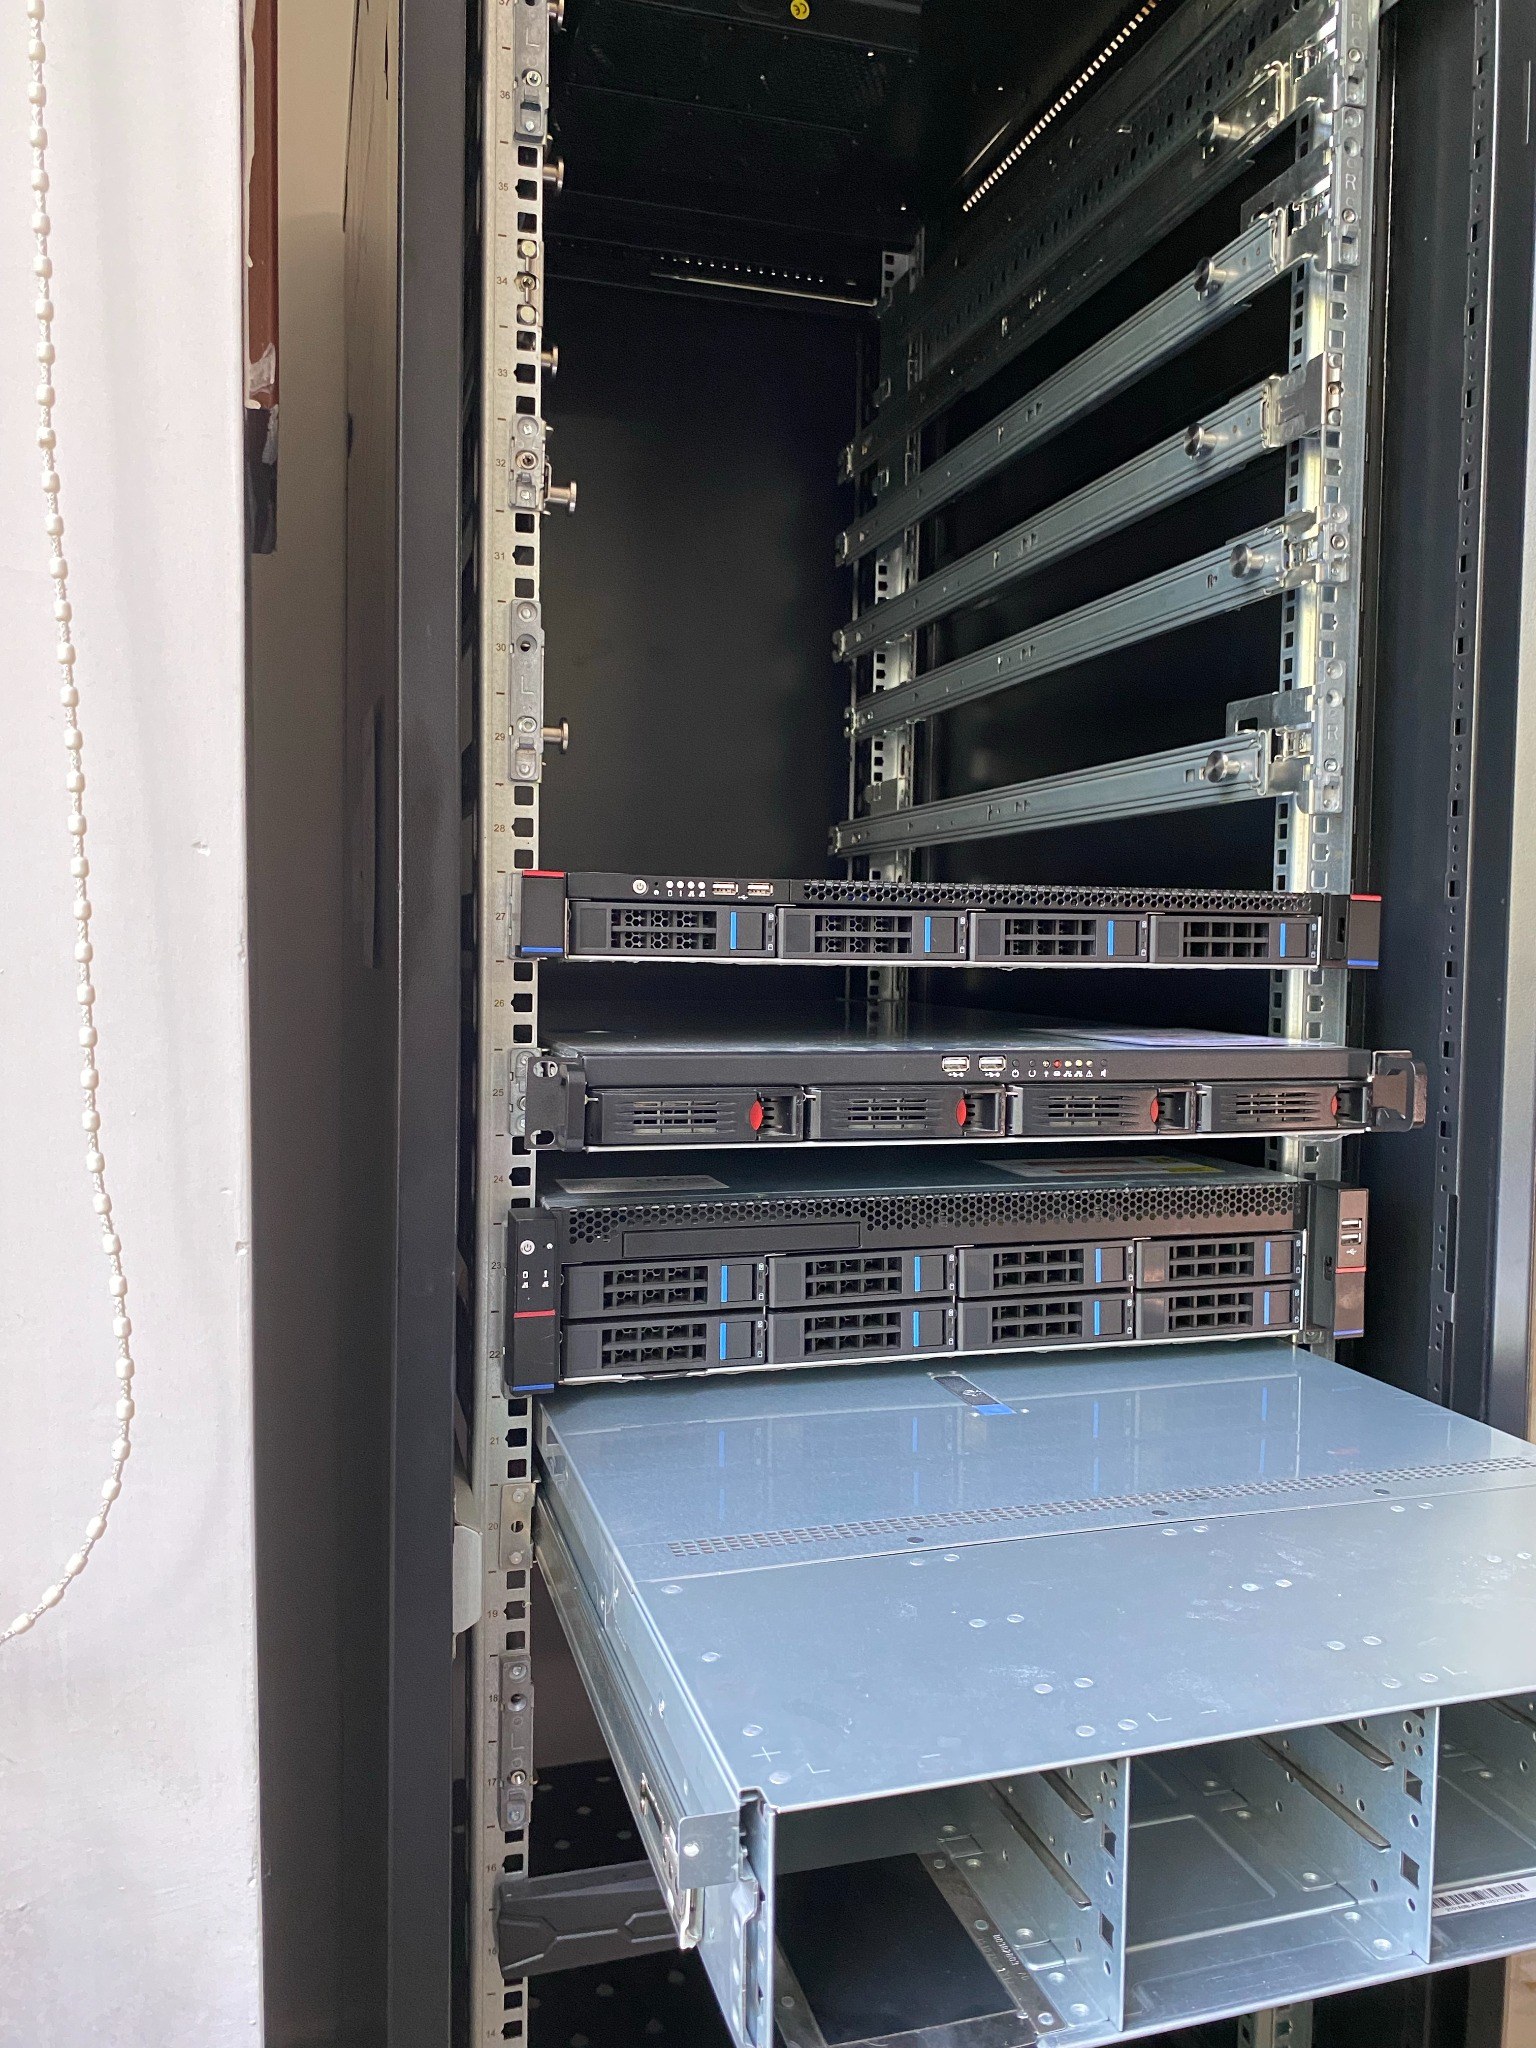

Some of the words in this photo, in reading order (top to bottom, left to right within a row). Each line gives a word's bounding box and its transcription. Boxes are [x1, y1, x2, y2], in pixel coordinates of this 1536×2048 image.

[500, 91, 511, 100] 36
[1345, 173, 1356, 190] R
[498, 182, 509, 191] 35
[496, 276, 508, 285] 34
[498, 368, 508, 377] 33
[496, 459, 506, 468] 32
[494, 552, 505, 560] 31
[496, 643, 506, 652] 30
[1327, 724, 1338, 740] R
[495, 733, 506, 741] 29
[494, 824, 506, 832] 28
[494, 1000, 504, 1008] 26
[492, 1089, 504, 1097] 25
[489, 1350, 500, 1358] 22
[488, 1522, 498, 1530] 20
[488, 1610, 498, 1618] 19
[488, 1778, 497, 1786] 17
